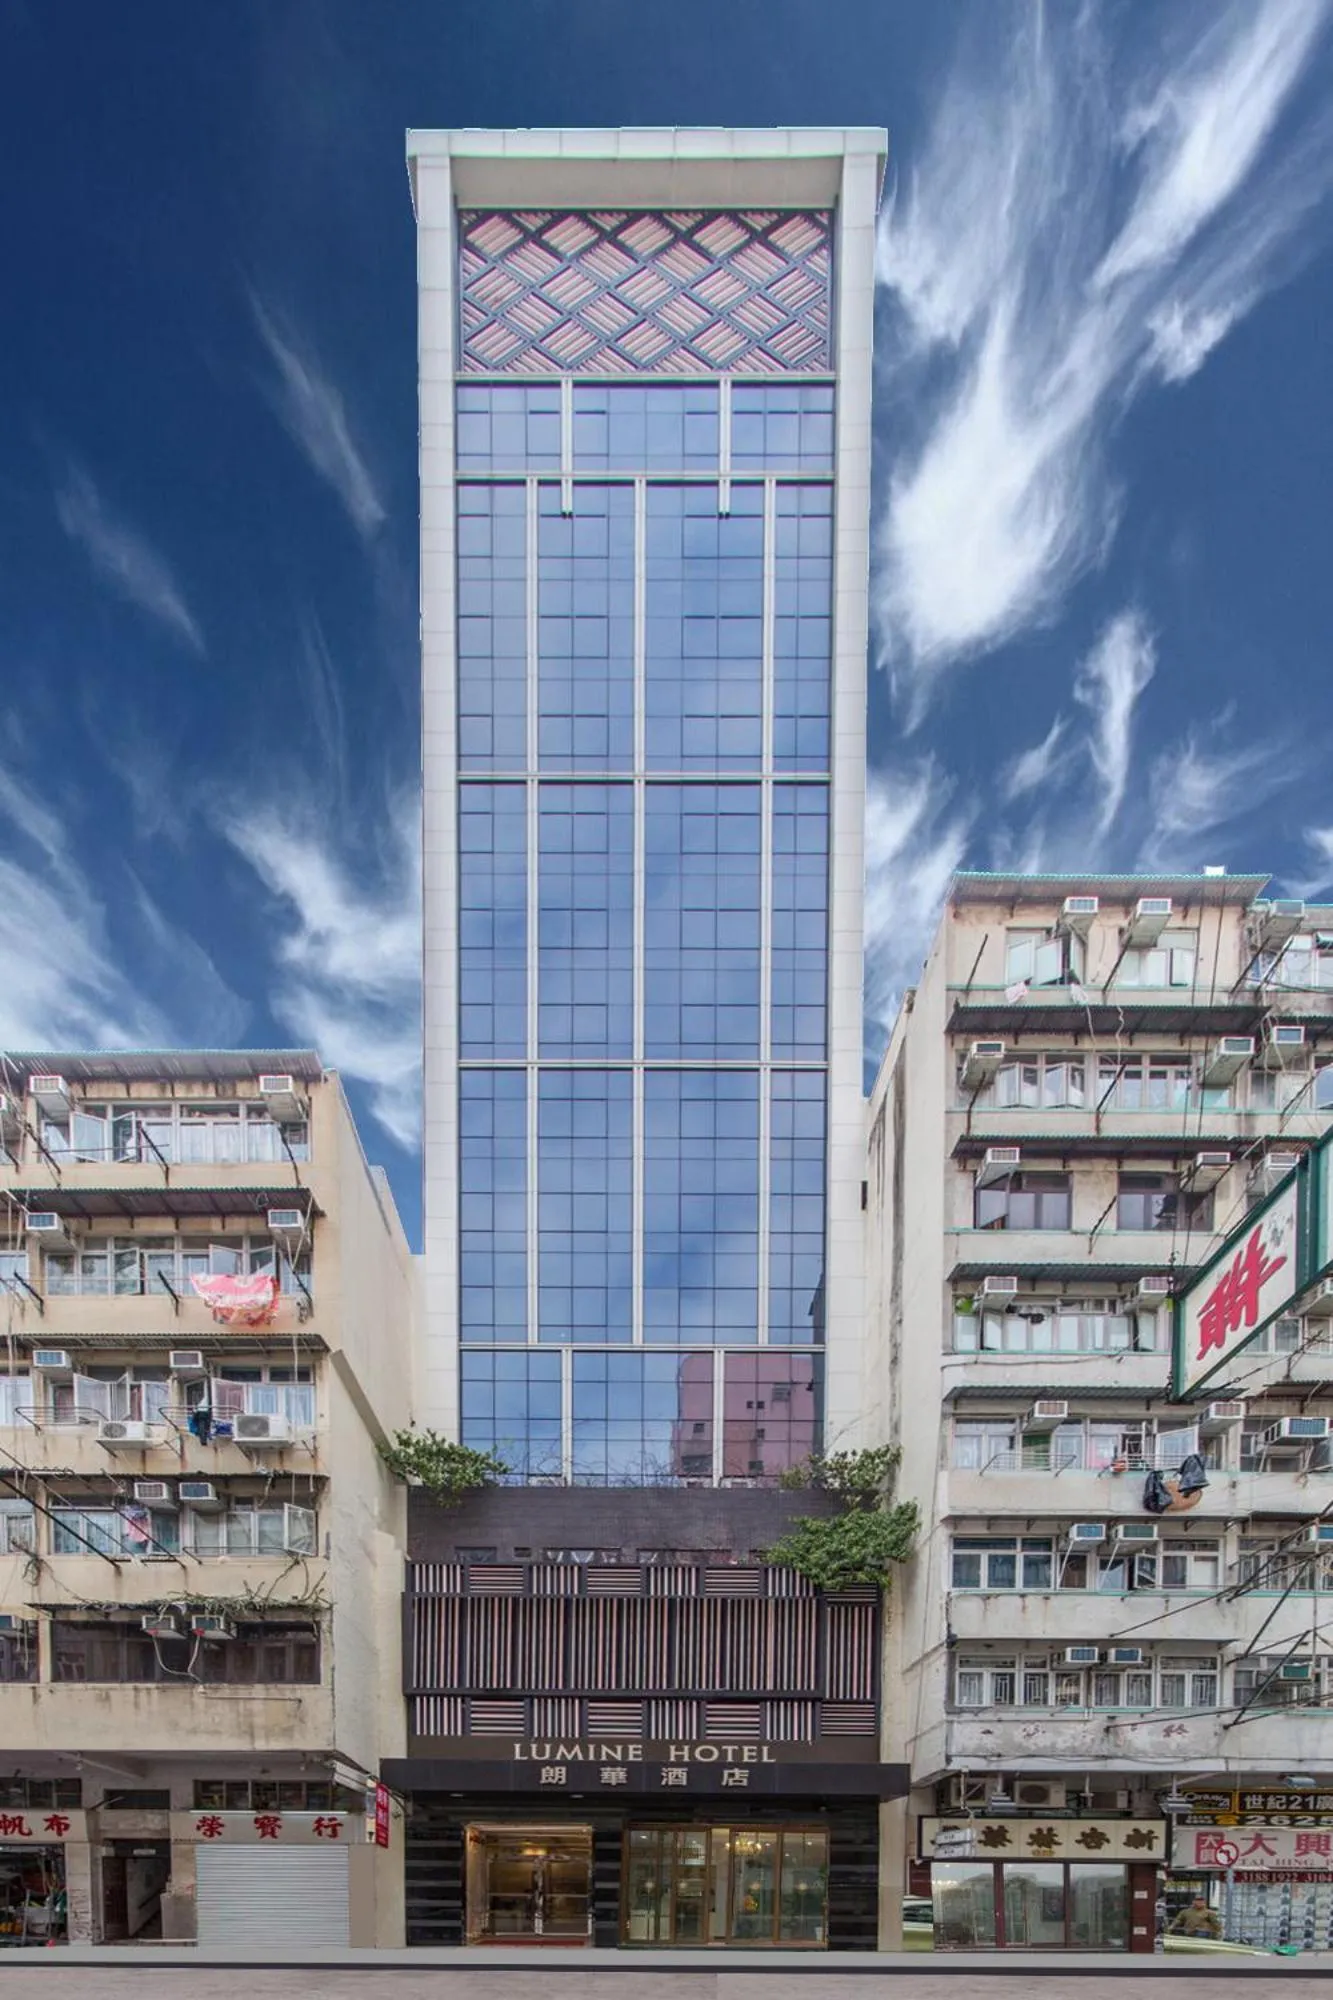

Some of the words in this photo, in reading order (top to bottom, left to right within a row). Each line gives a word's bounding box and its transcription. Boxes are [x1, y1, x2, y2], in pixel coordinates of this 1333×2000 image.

[513, 1743, 643, 1761] LUMINE
[669, 1744, 777, 1763] HOTEL
[540, 1766, 749, 1786] 朗華酒店
[1240, 1832, 1332, 1857] 大興
